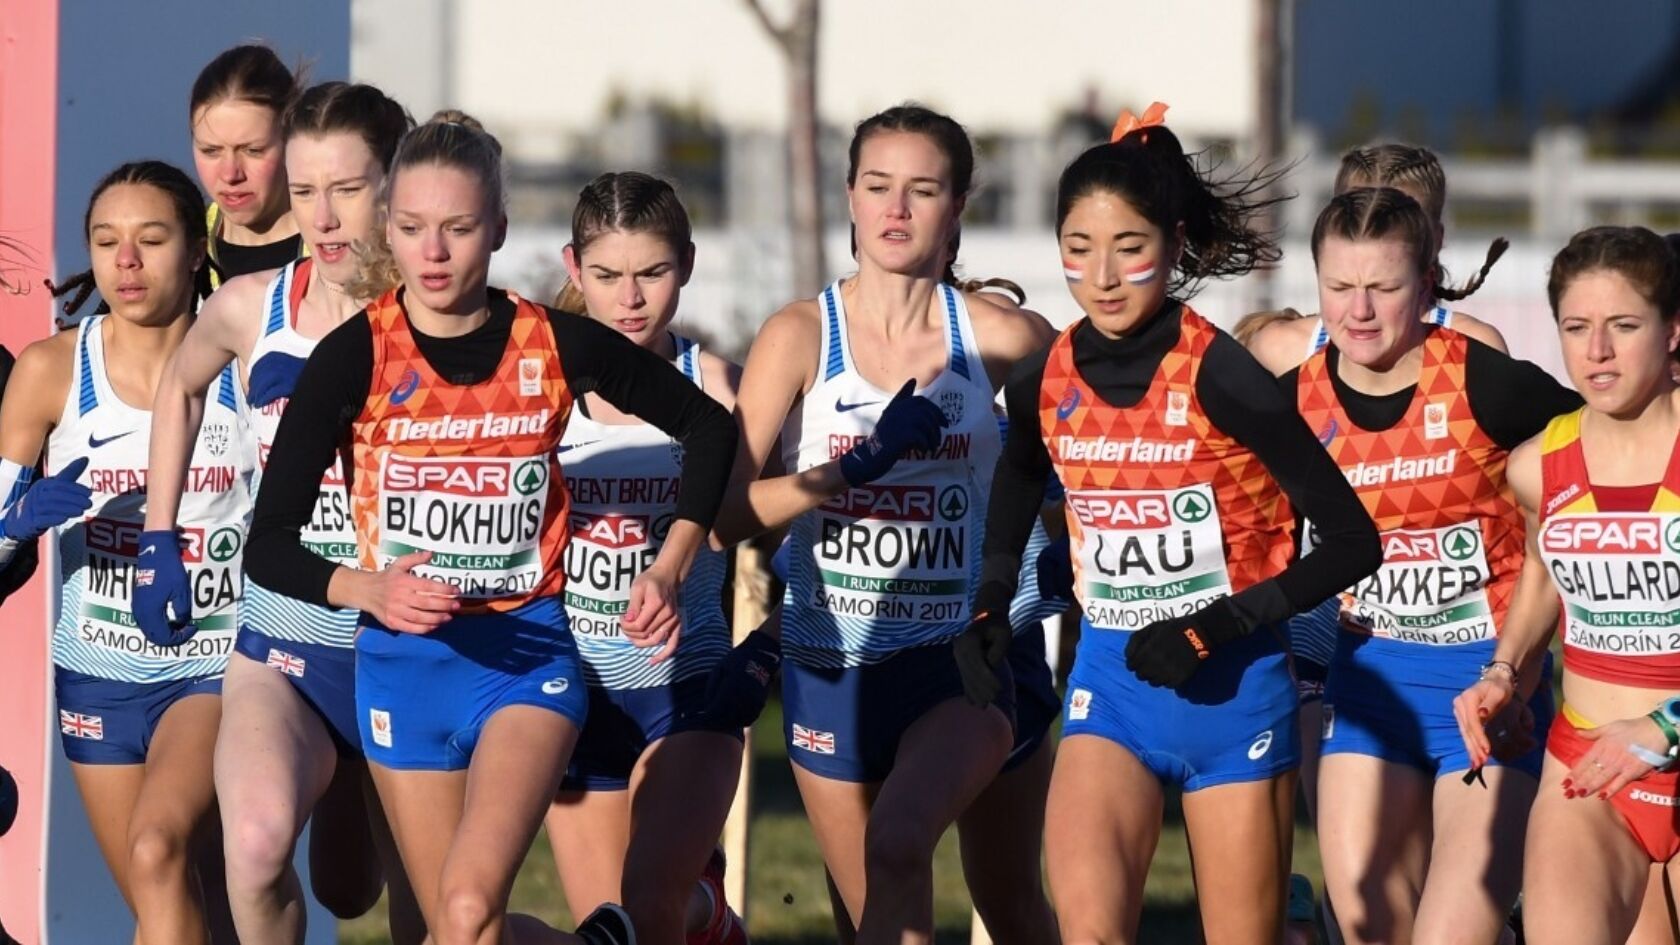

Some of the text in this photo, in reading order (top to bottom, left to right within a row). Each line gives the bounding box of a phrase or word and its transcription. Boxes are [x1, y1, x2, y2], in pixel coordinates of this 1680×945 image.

[387, 463, 507, 493] SPAR
[565, 477, 616, 504] REAT
[822, 487, 931, 517] SPAR
[1072, 498, 1168, 525] SPAR
[387, 496, 541, 545] BLOKHUIS
[569, 516, 644, 544] PAR
[90, 519, 200, 558] SPR
[821, 518, 965, 569] BROWN
[1545, 521, 1659, 550] SPAR
[1094, 530, 1195, 577] LAU
[493, 571, 537, 595] 2017
[850, 578, 881, 592] RUN
[1353, 565, 1482, 606] AKKER
[571, 594, 599, 612] RUN
[919, 602, 962, 620] 2017
[1593, 612, 1625, 625] RUN
[186, 637, 232, 657] 2017
[1444, 622, 1488, 644] 2017
[1569, 620, 1663, 652] ŠAMORÍN
